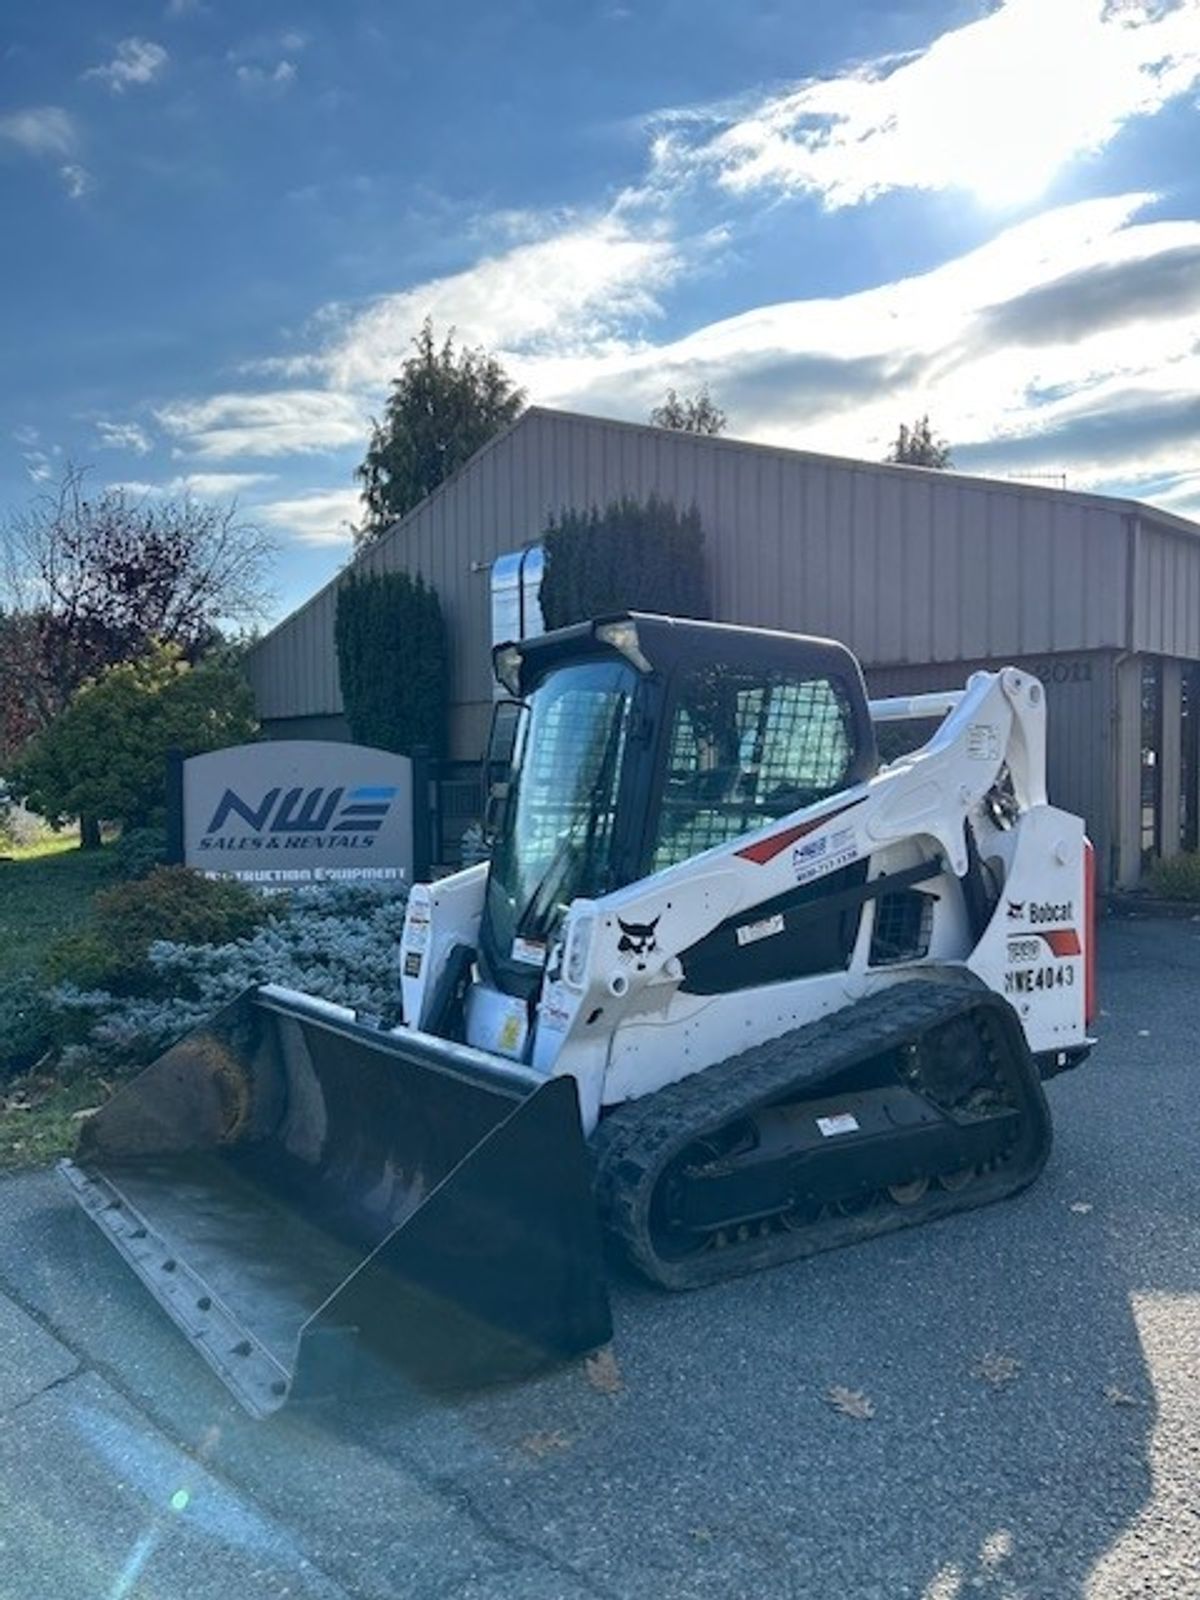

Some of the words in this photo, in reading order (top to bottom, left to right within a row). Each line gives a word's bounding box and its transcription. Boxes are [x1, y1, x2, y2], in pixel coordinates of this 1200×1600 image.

[1036, 661, 1092, 683] 2011
[206, 785, 398, 834] NWE
[200, 835, 262, 851] SALES
[284, 835, 376, 850] RENTALS
[1030, 901, 1074, 924] Bobcat
[1004, 965, 1075, 994] NWE4043
